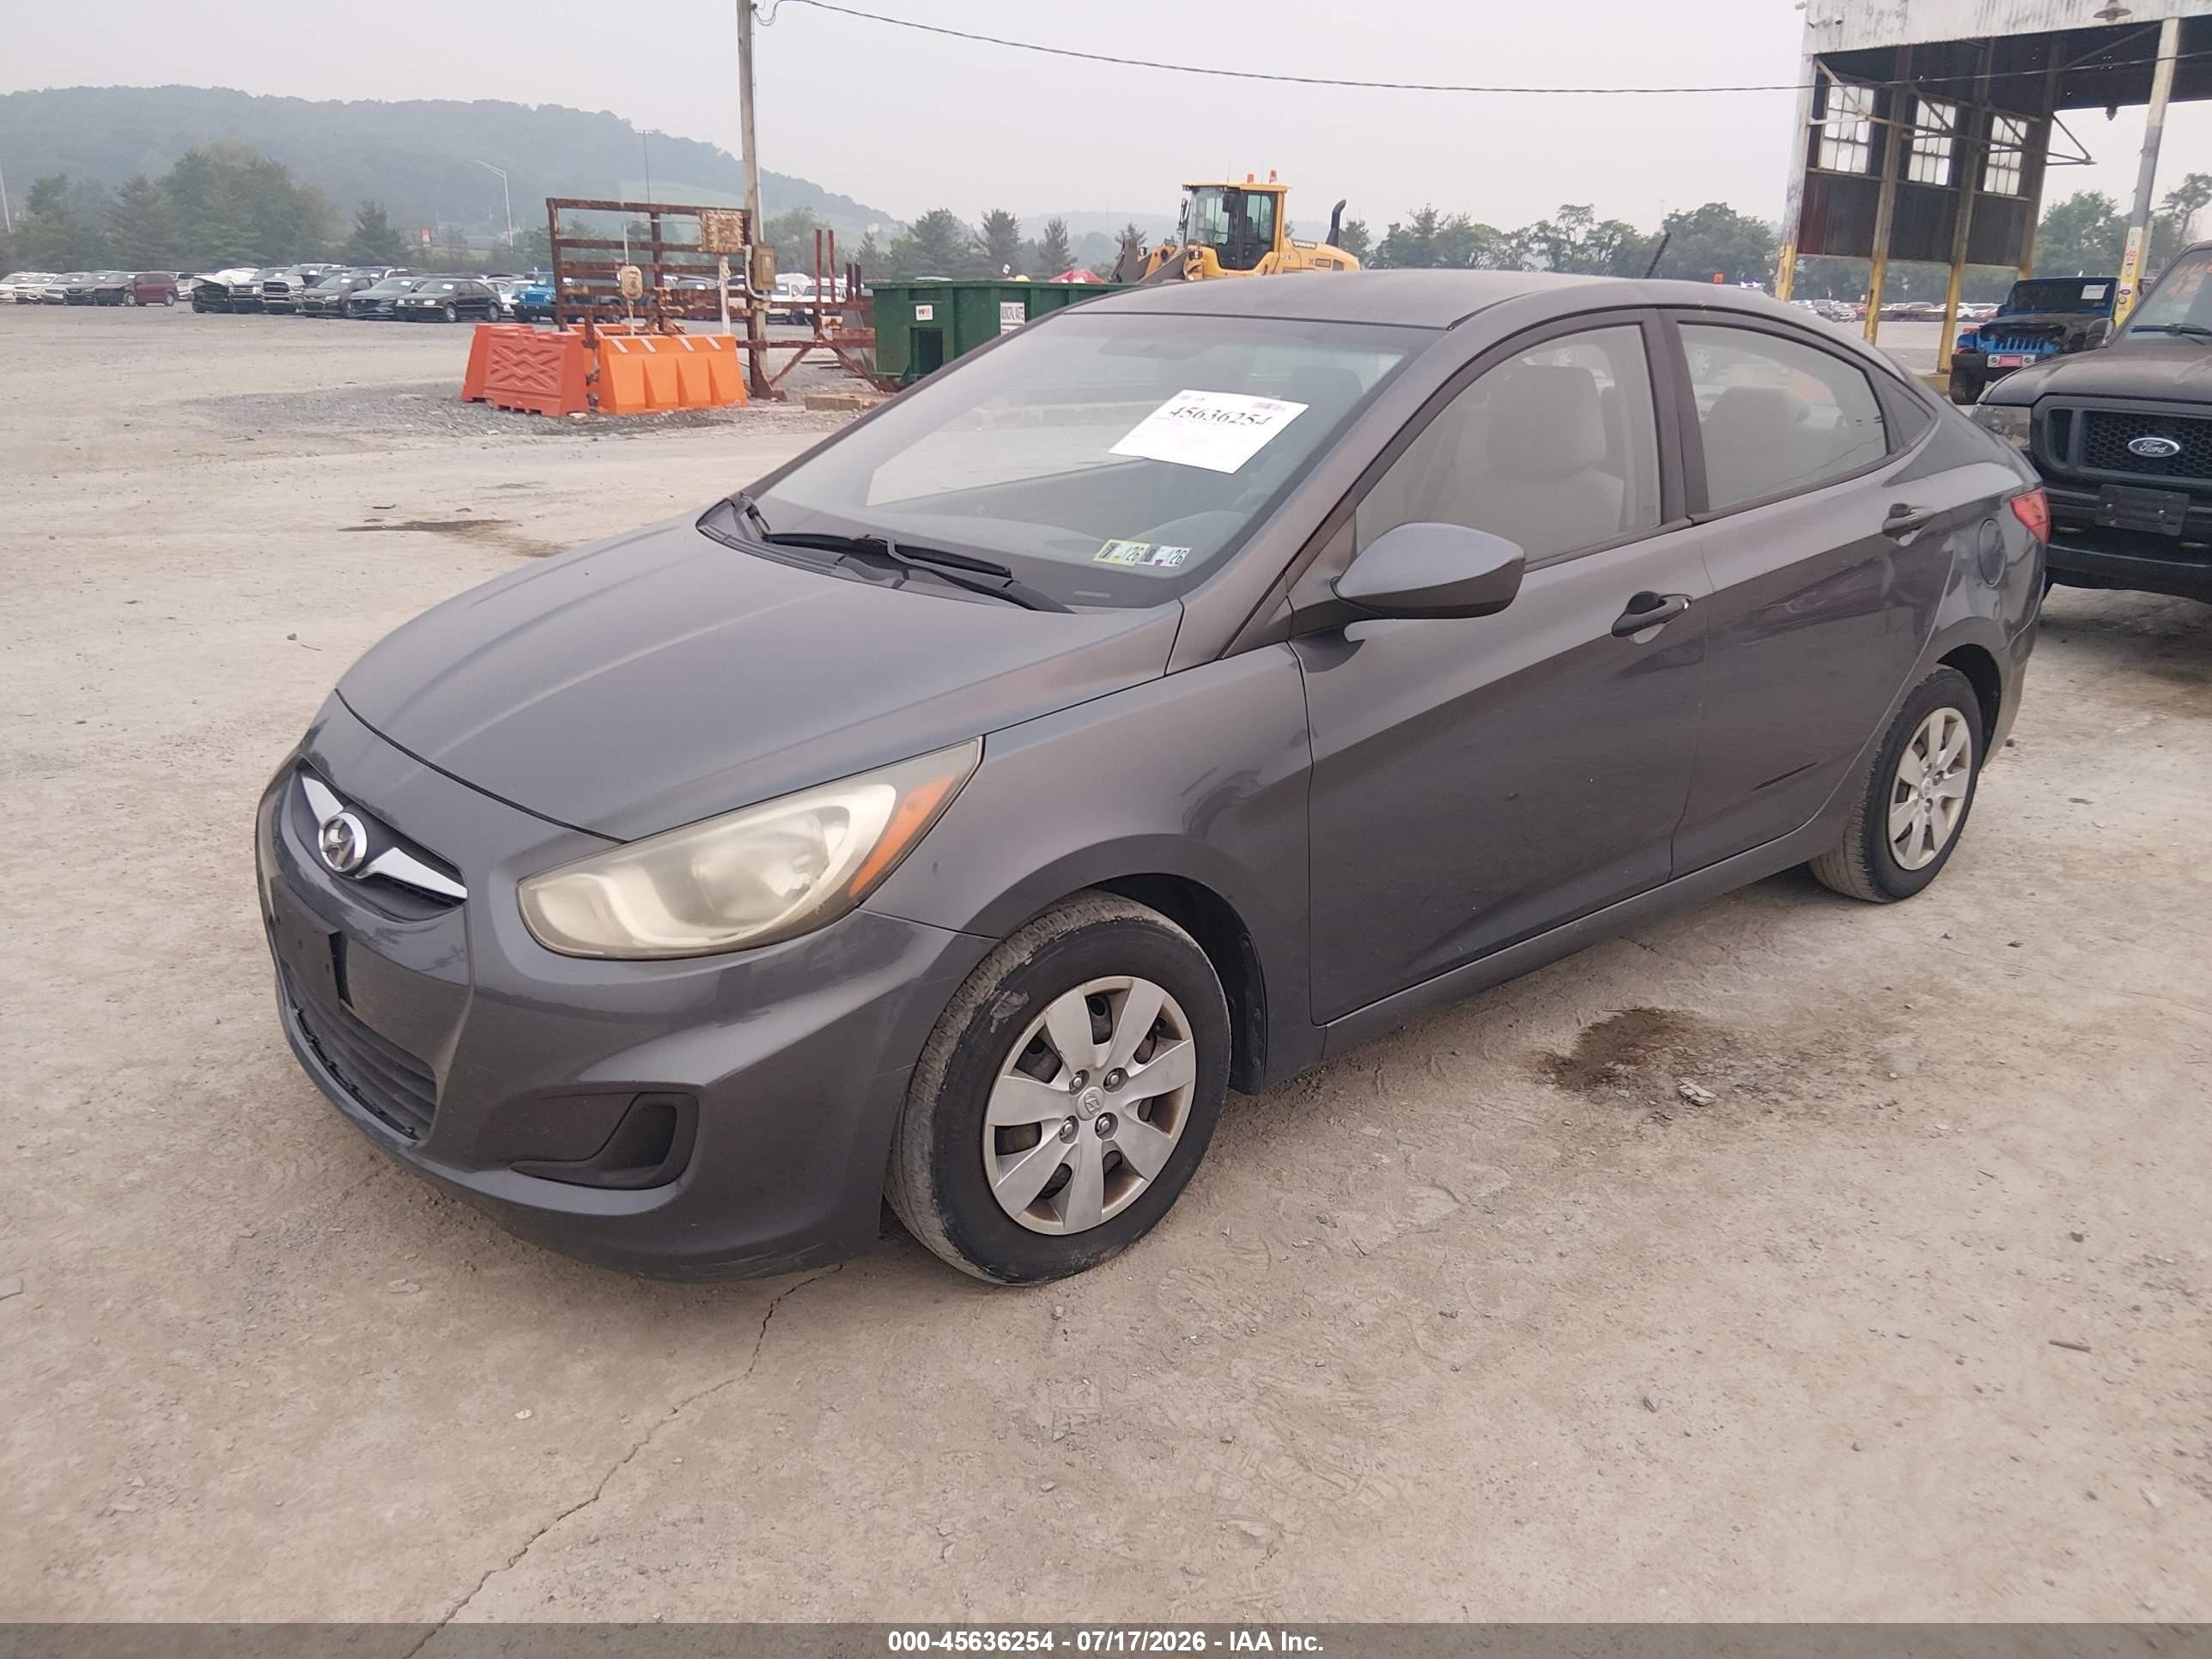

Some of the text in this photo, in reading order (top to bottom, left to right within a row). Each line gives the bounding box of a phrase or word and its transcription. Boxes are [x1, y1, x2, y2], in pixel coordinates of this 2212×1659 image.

[1170, 406, 1273, 425] 45636254
[2139, 441, 2169, 453] Ford
[1170, 549, 1187, 564] 26
